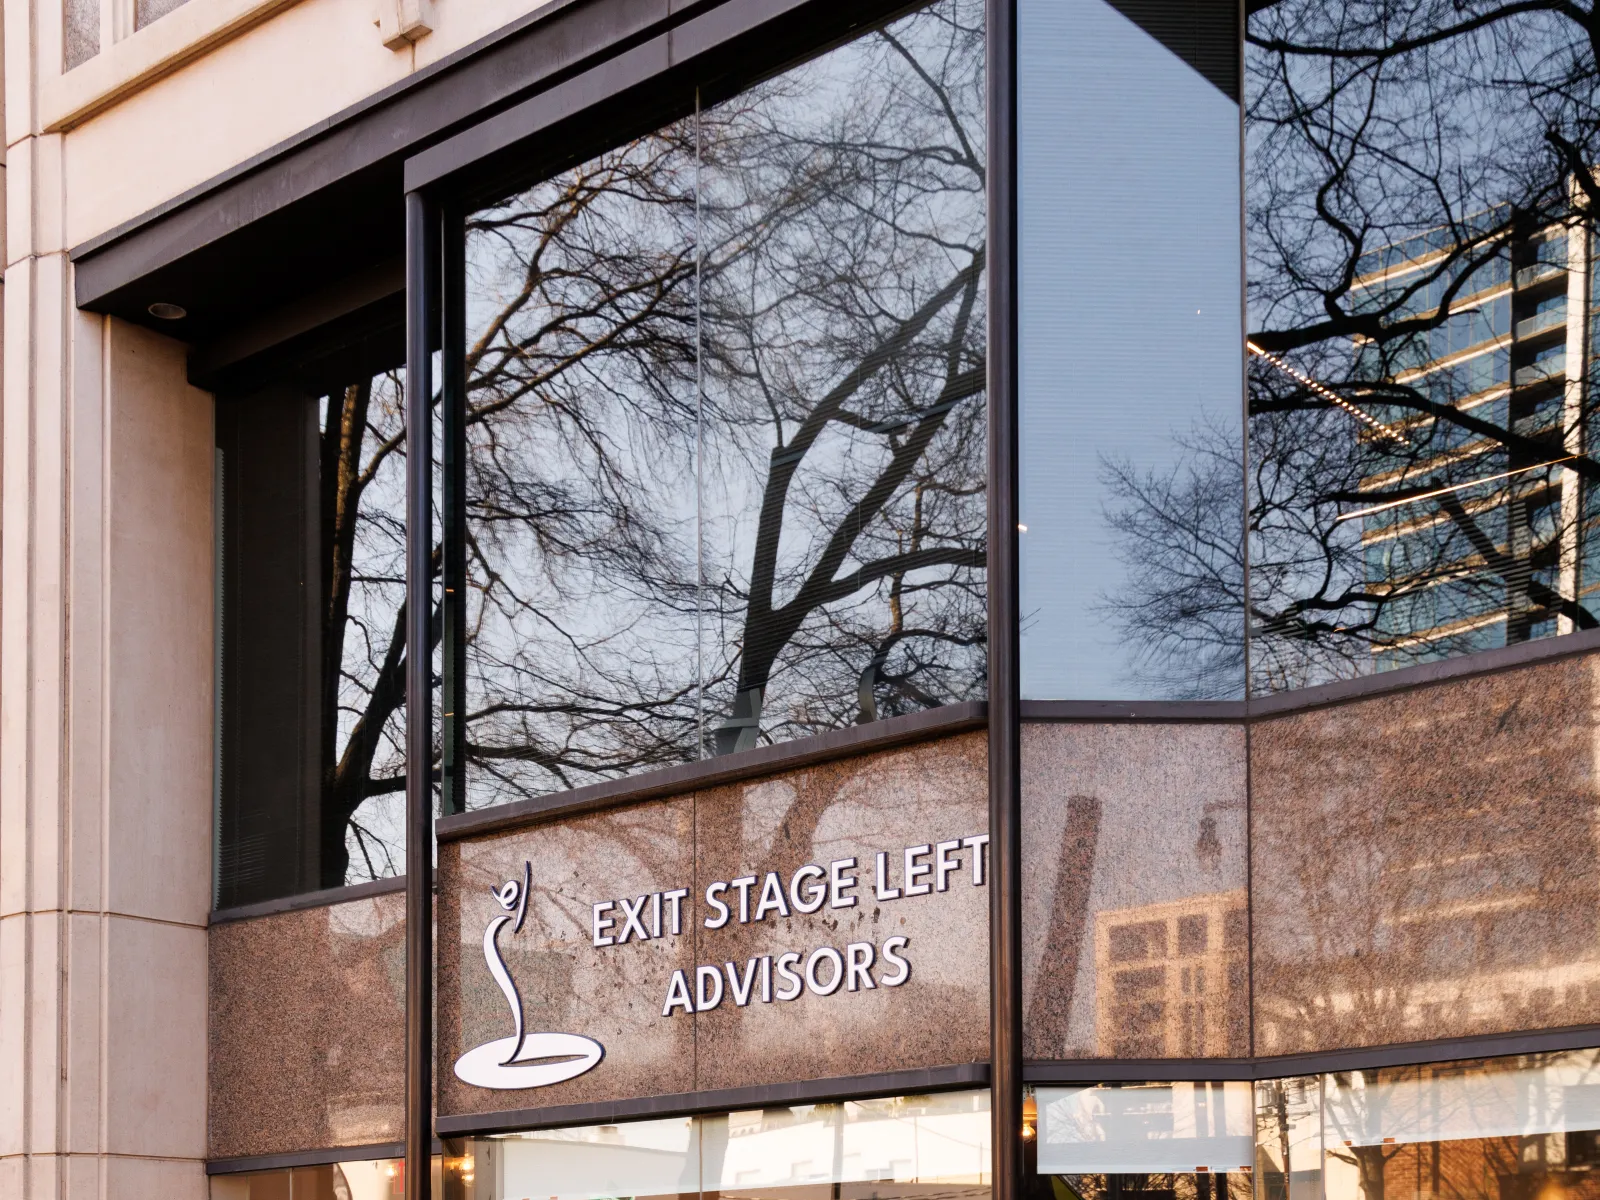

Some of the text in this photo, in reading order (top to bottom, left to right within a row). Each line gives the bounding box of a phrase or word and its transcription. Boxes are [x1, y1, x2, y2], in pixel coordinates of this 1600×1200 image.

[592, 834, 990, 947] EXIT STAGE LEFT
[662, 936, 912, 1017] ADVISORS
